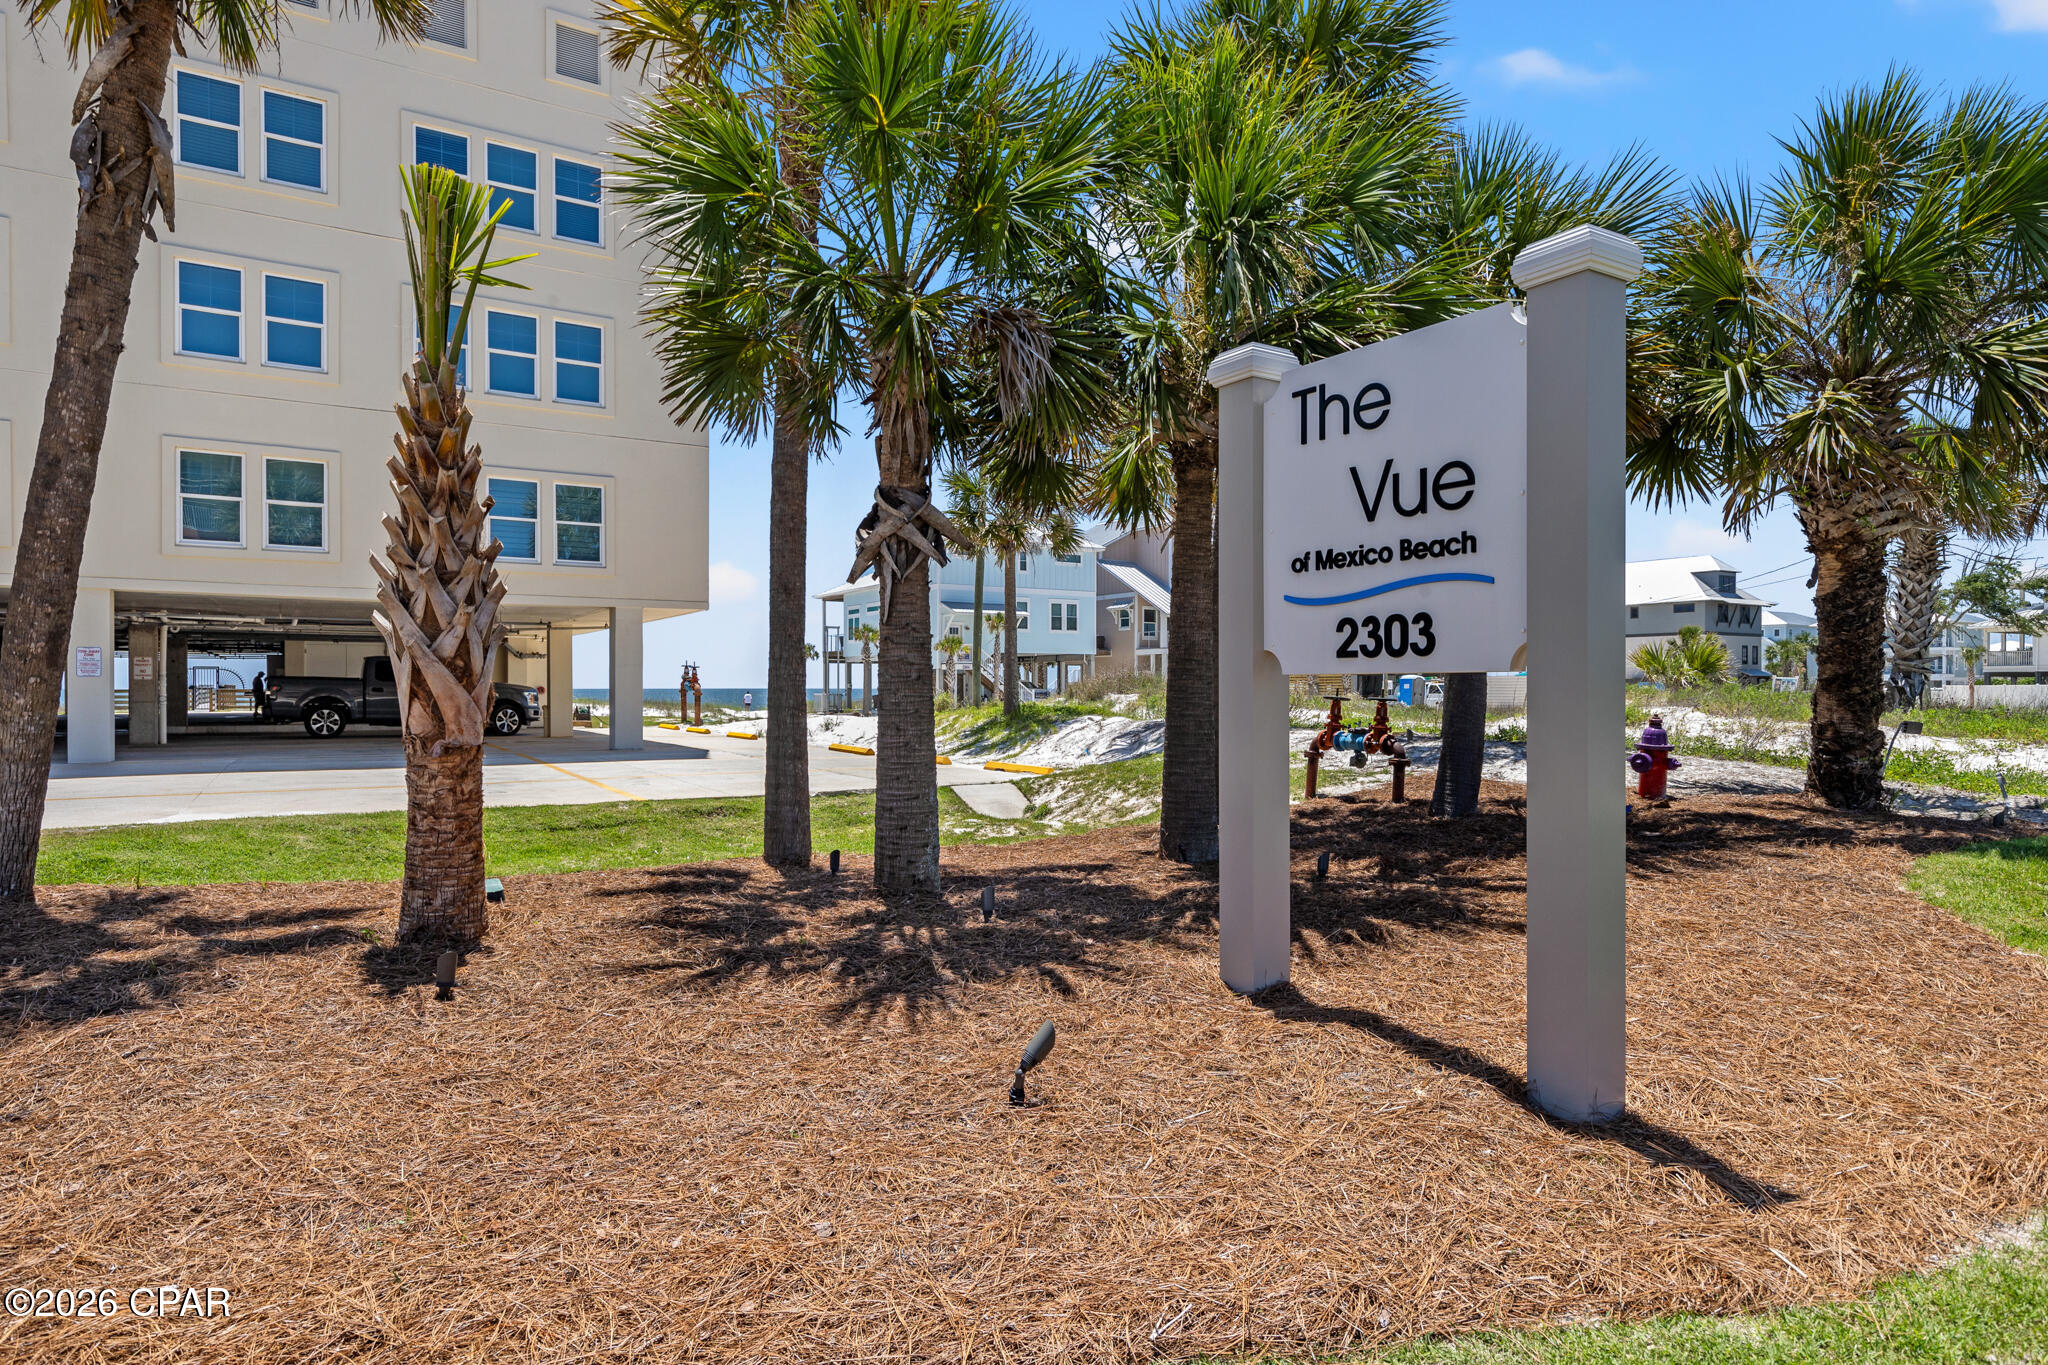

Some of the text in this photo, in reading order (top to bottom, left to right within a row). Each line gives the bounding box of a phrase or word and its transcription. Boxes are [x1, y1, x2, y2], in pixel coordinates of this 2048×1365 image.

[1291, 382, 1391, 445] The
[1349, 459, 1476, 522] Vue
[1291, 531, 1477, 573] of Mexico Beach
[1336, 612, 1436, 659] 2303
